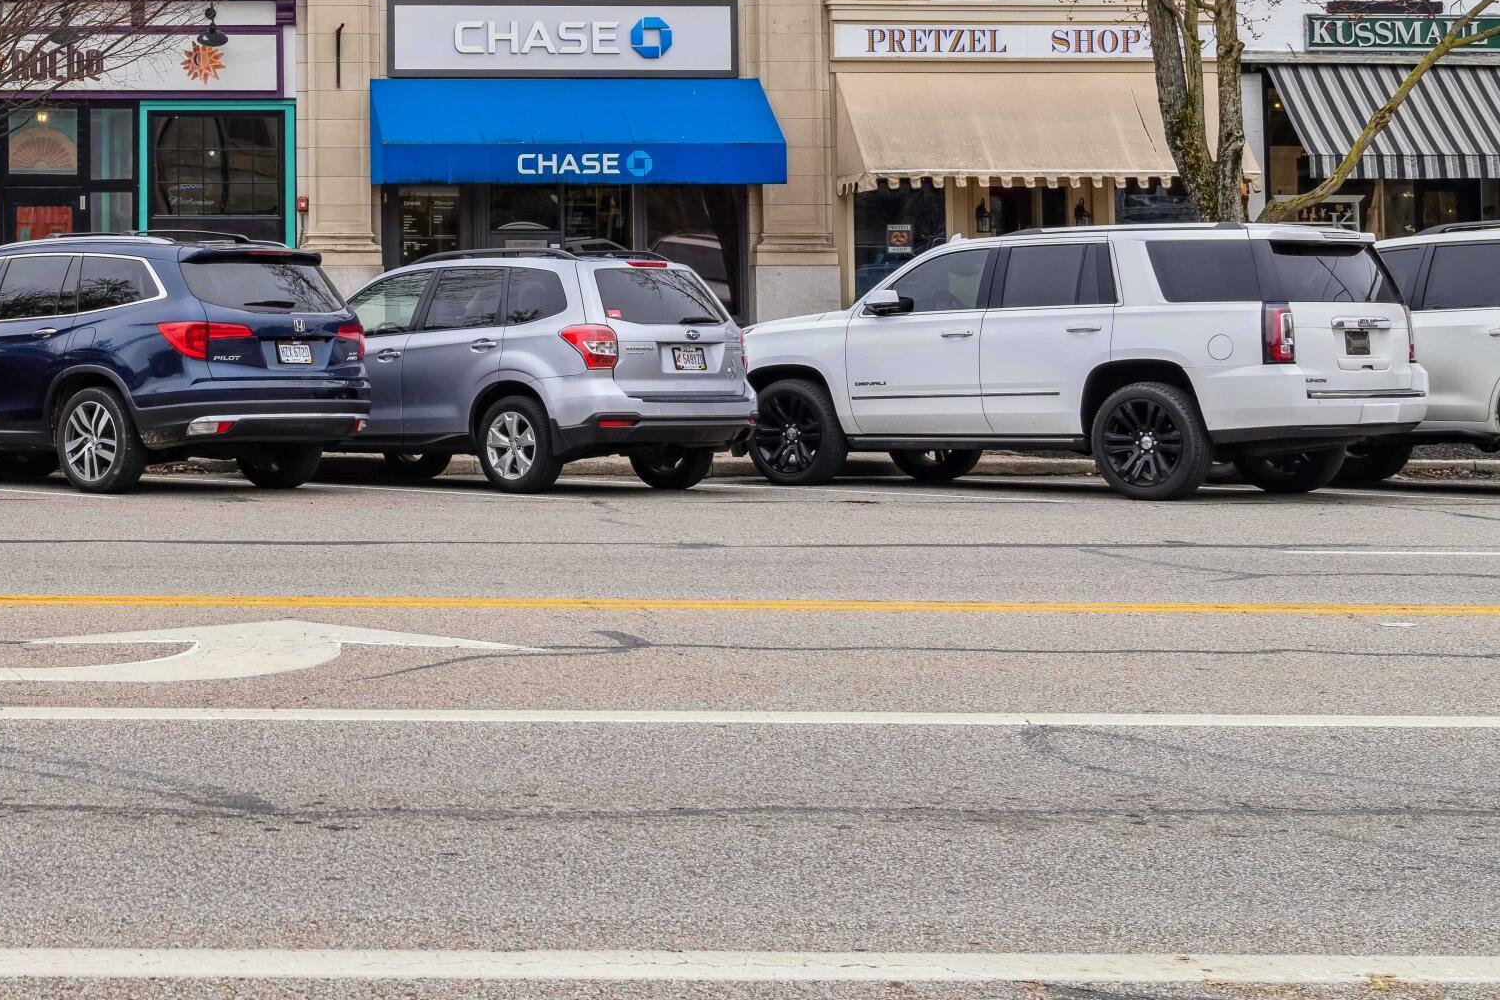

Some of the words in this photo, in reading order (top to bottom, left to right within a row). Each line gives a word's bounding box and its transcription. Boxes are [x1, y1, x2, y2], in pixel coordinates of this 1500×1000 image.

[454, 21, 621, 54] CHASE
[865, 28, 1008, 54] PRETZEL
[1051, 28, 1142, 55] SHOP
[517, 153, 621, 175] CHASE
